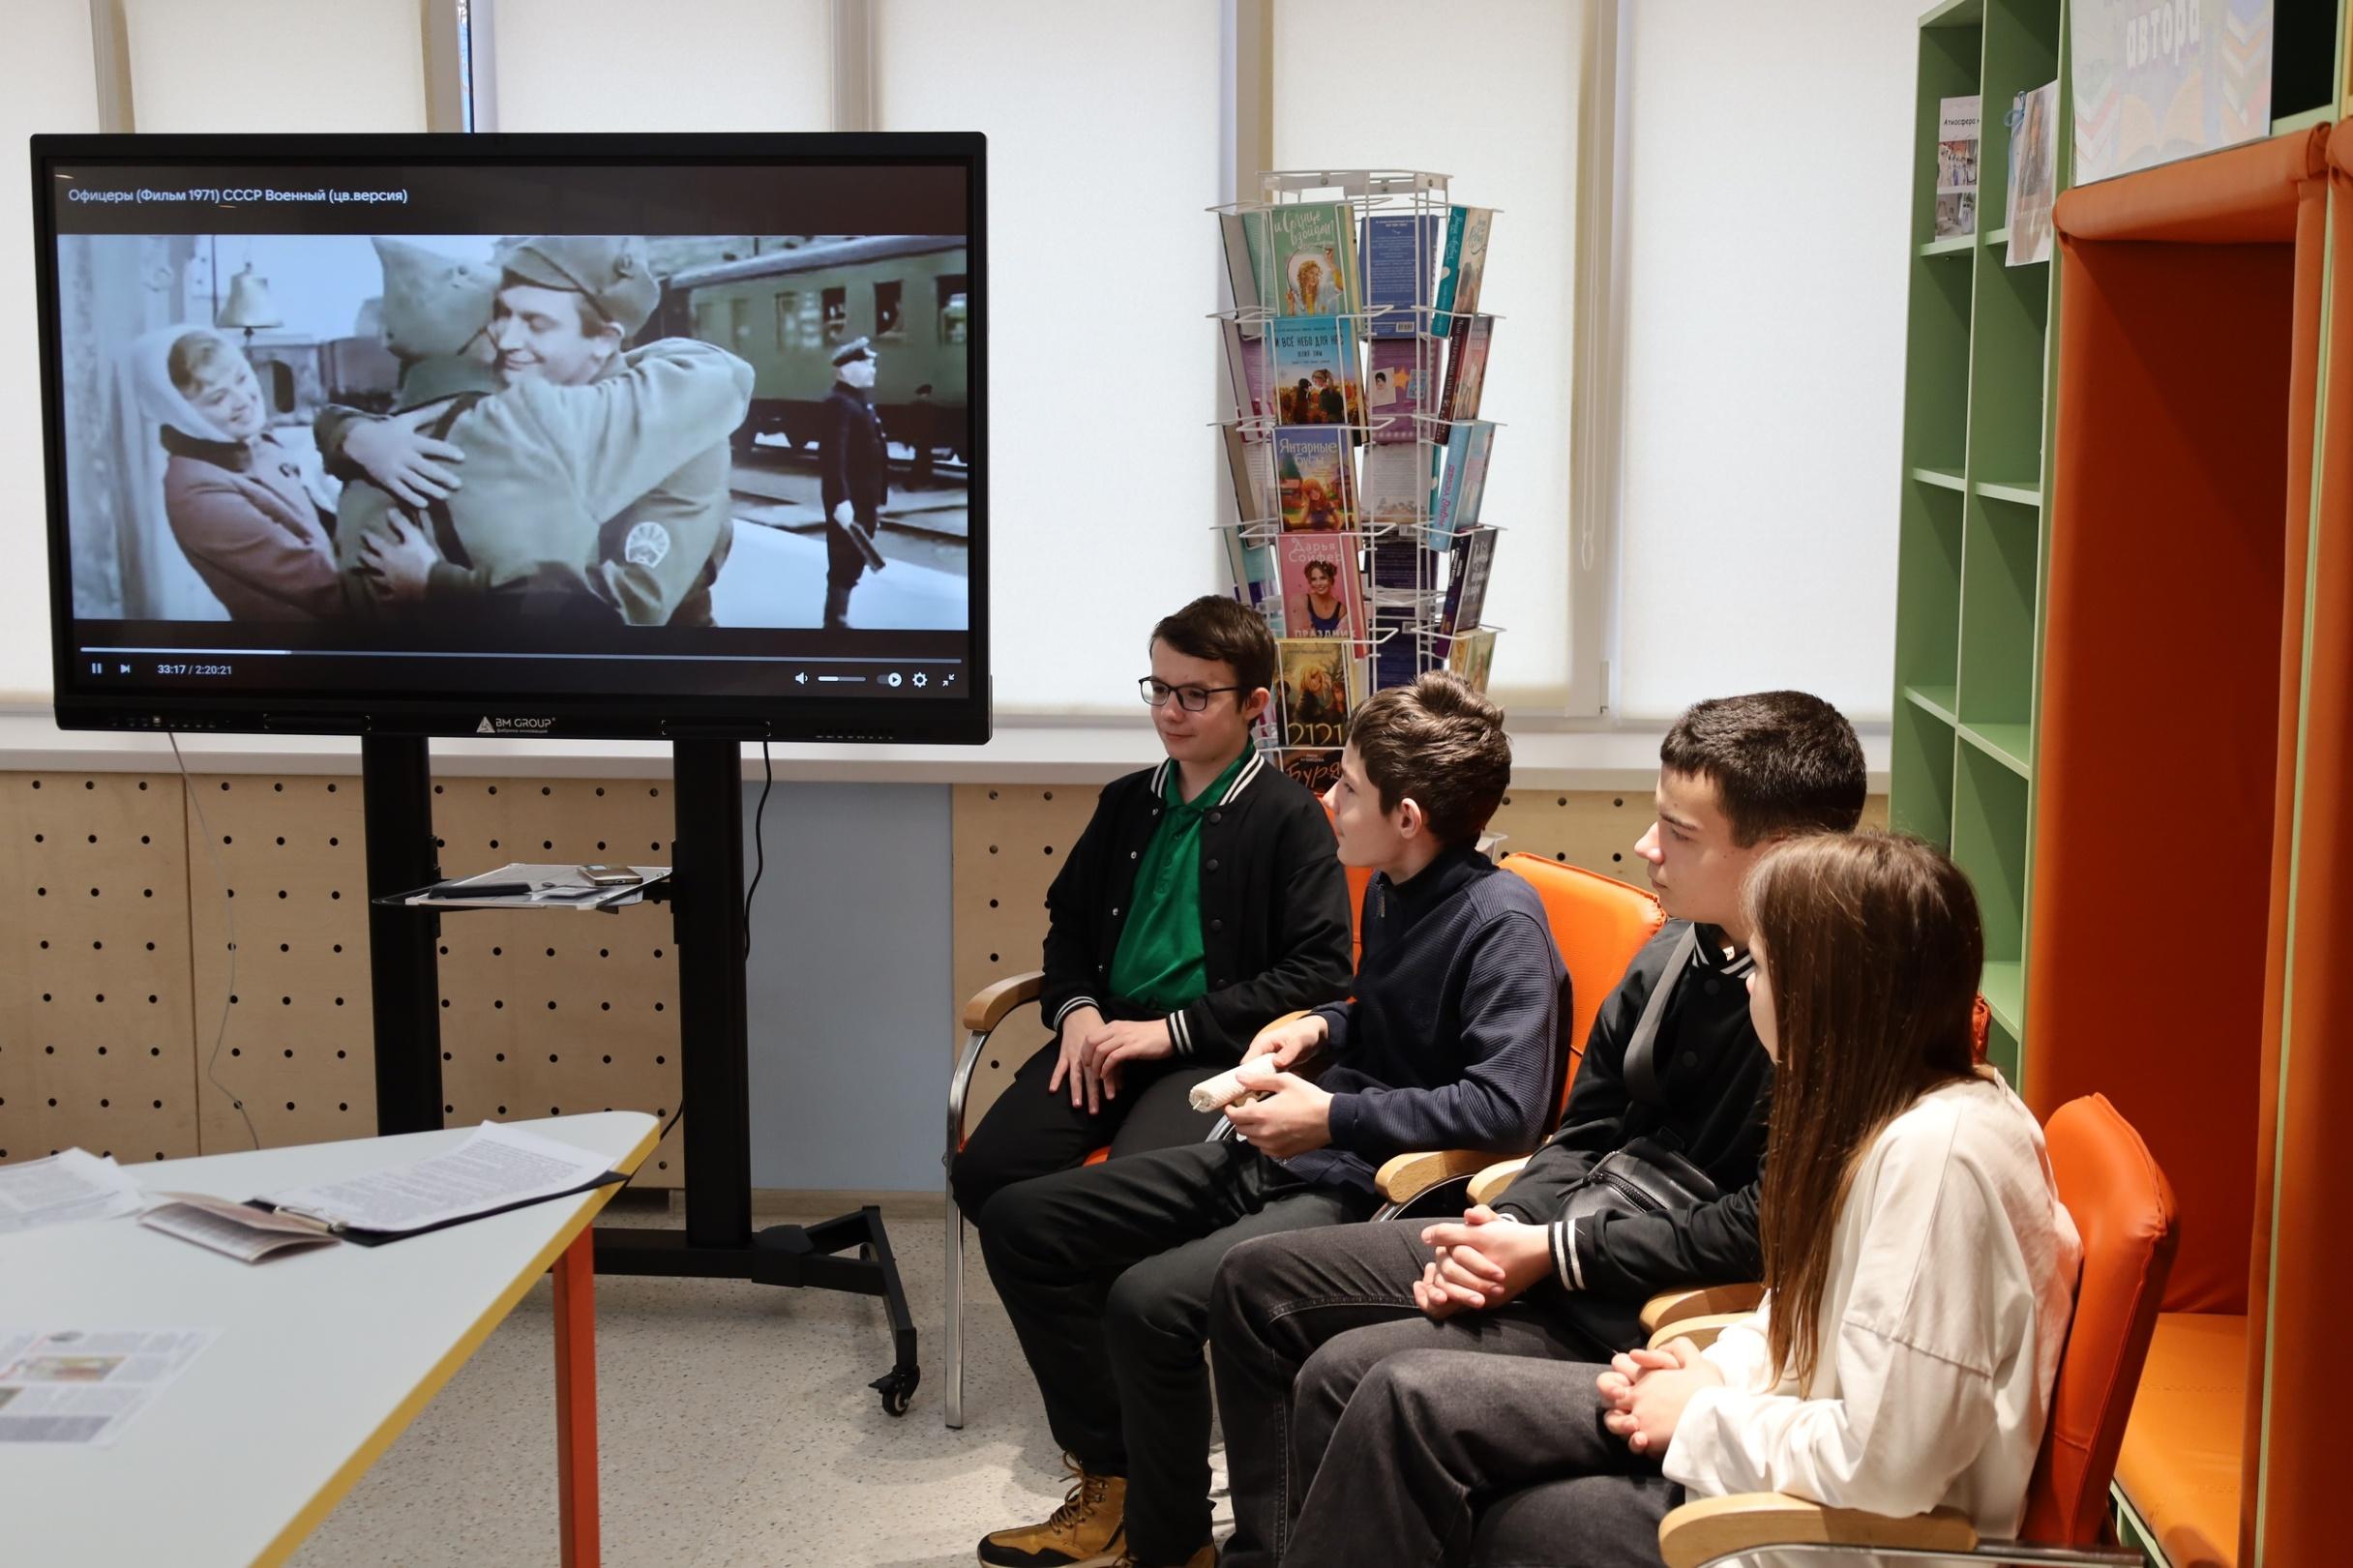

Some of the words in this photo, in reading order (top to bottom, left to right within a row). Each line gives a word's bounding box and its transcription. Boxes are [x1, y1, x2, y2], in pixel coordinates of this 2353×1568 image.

[68, 188, 134, 204] Офицеры
[135, 188, 187, 204] (Фильм
[188, 189, 221, 204] 1971)
[222, 189, 263, 202] СССР
[264, 188, 327, 202] Военный
[328, 188, 408, 205] (цв.версия)
[1279, 438, 1338, 454] Янтарные
[1292, 538, 1335, 553] Дарья
[157, 664, 186, 674] 33:17
[188, 665, 194, 674] /
[194, 665, 232, 675] 2:20:21
[495, 718, 512, 727] BM
[514, 718, 551, 728] GROUP
[1288, 723, 1343, 746] 2121
